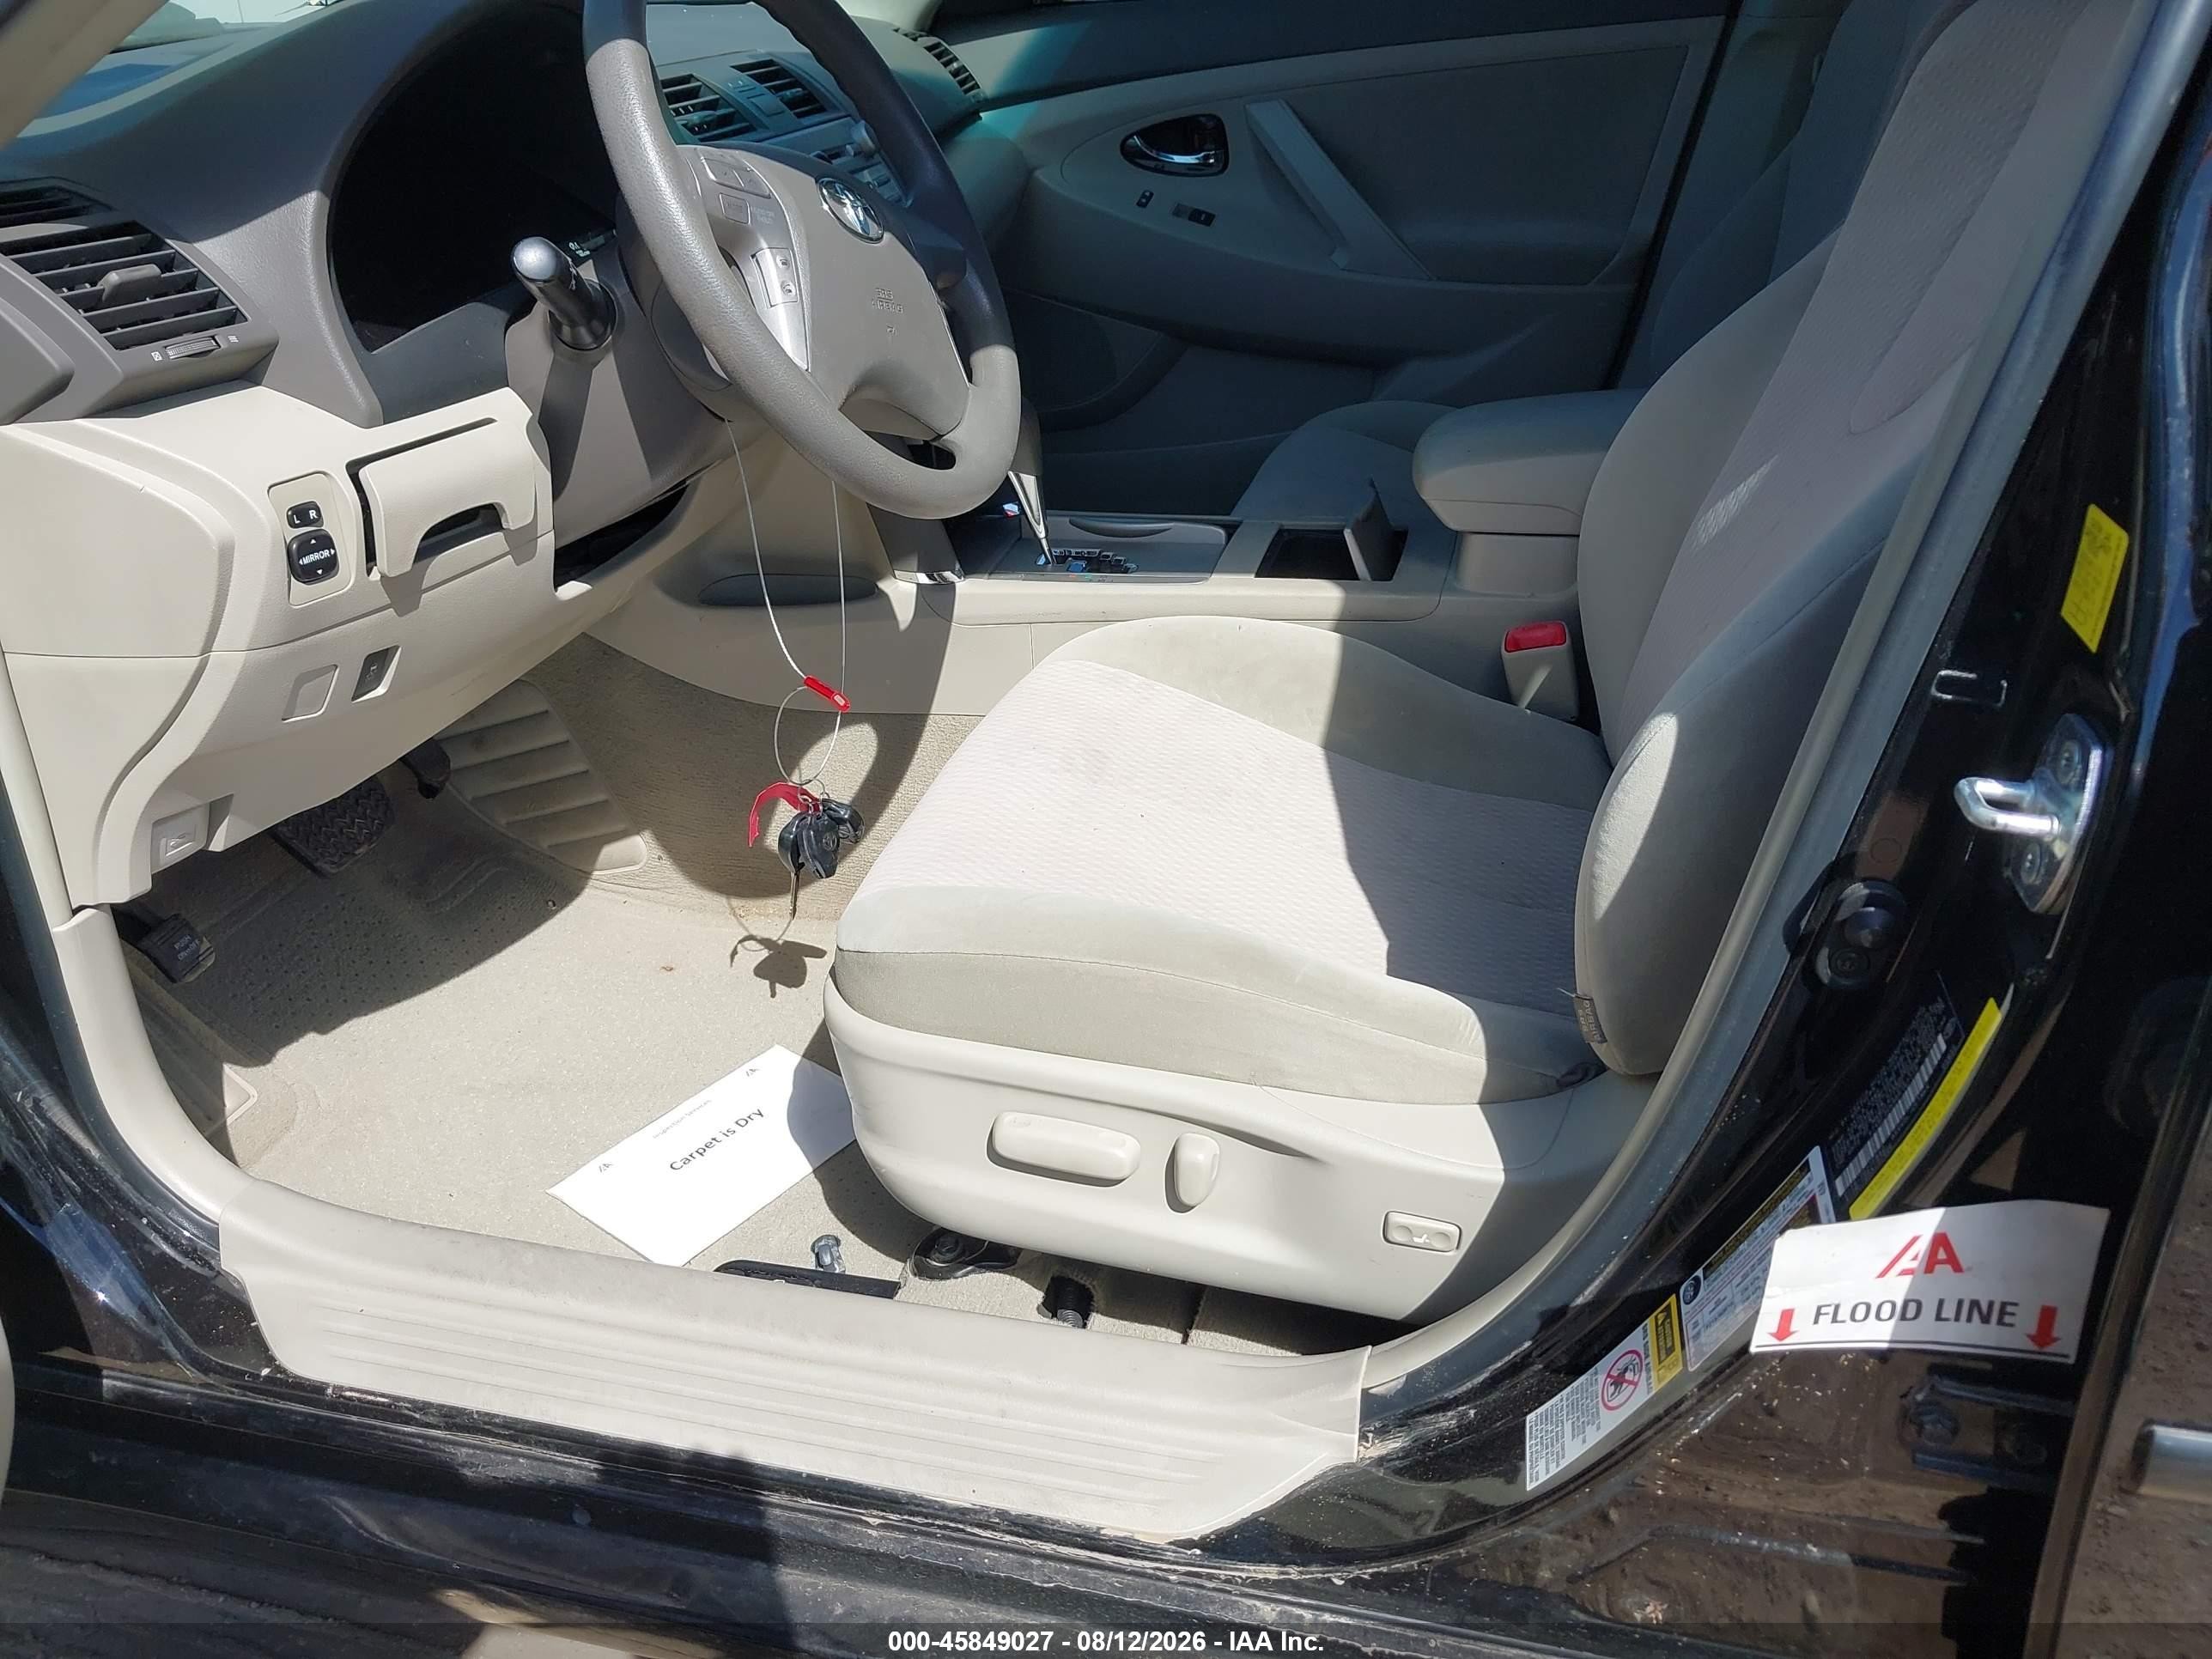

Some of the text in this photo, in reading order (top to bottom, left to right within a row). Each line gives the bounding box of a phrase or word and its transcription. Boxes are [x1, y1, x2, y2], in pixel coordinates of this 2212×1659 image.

[293, 509, 319, 524] L R
[301, 549, 331, 565] MIRROR
[670, 1108, 764, 1170] Carpet is Dry
[1812, 1297, 2021, 1328] FLOOD LINE
